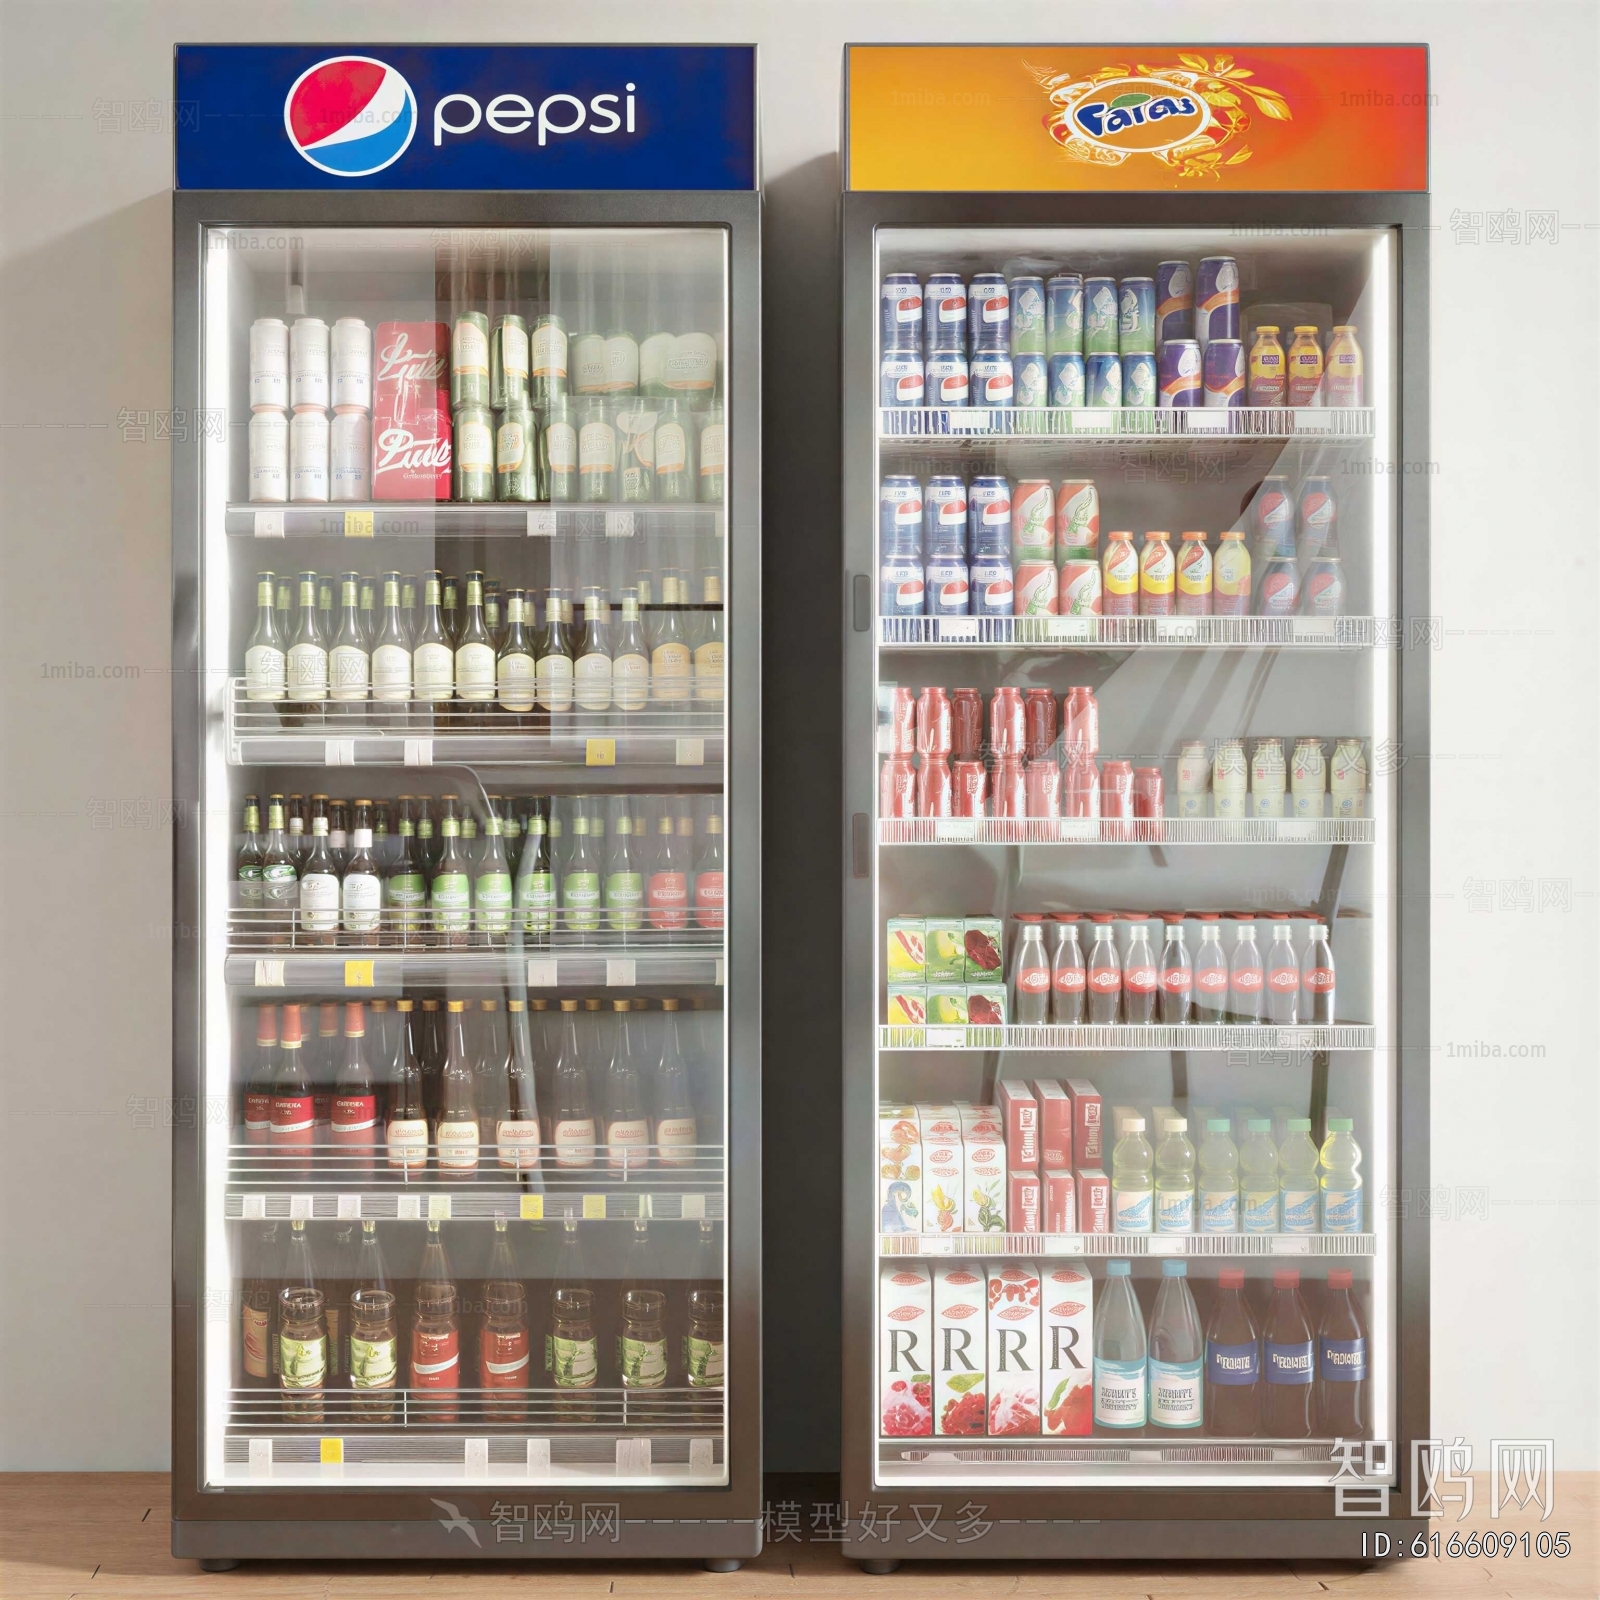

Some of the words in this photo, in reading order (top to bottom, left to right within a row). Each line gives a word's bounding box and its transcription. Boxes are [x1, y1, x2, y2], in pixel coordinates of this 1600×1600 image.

[433, 82, 636, 147] pepsi
[887, 1328, 926, 1373] R
[940, 1327, 980, 1371] R
[995, 1328, 1035, 1373] R
[1048, 1325, 1088, 1370] R
